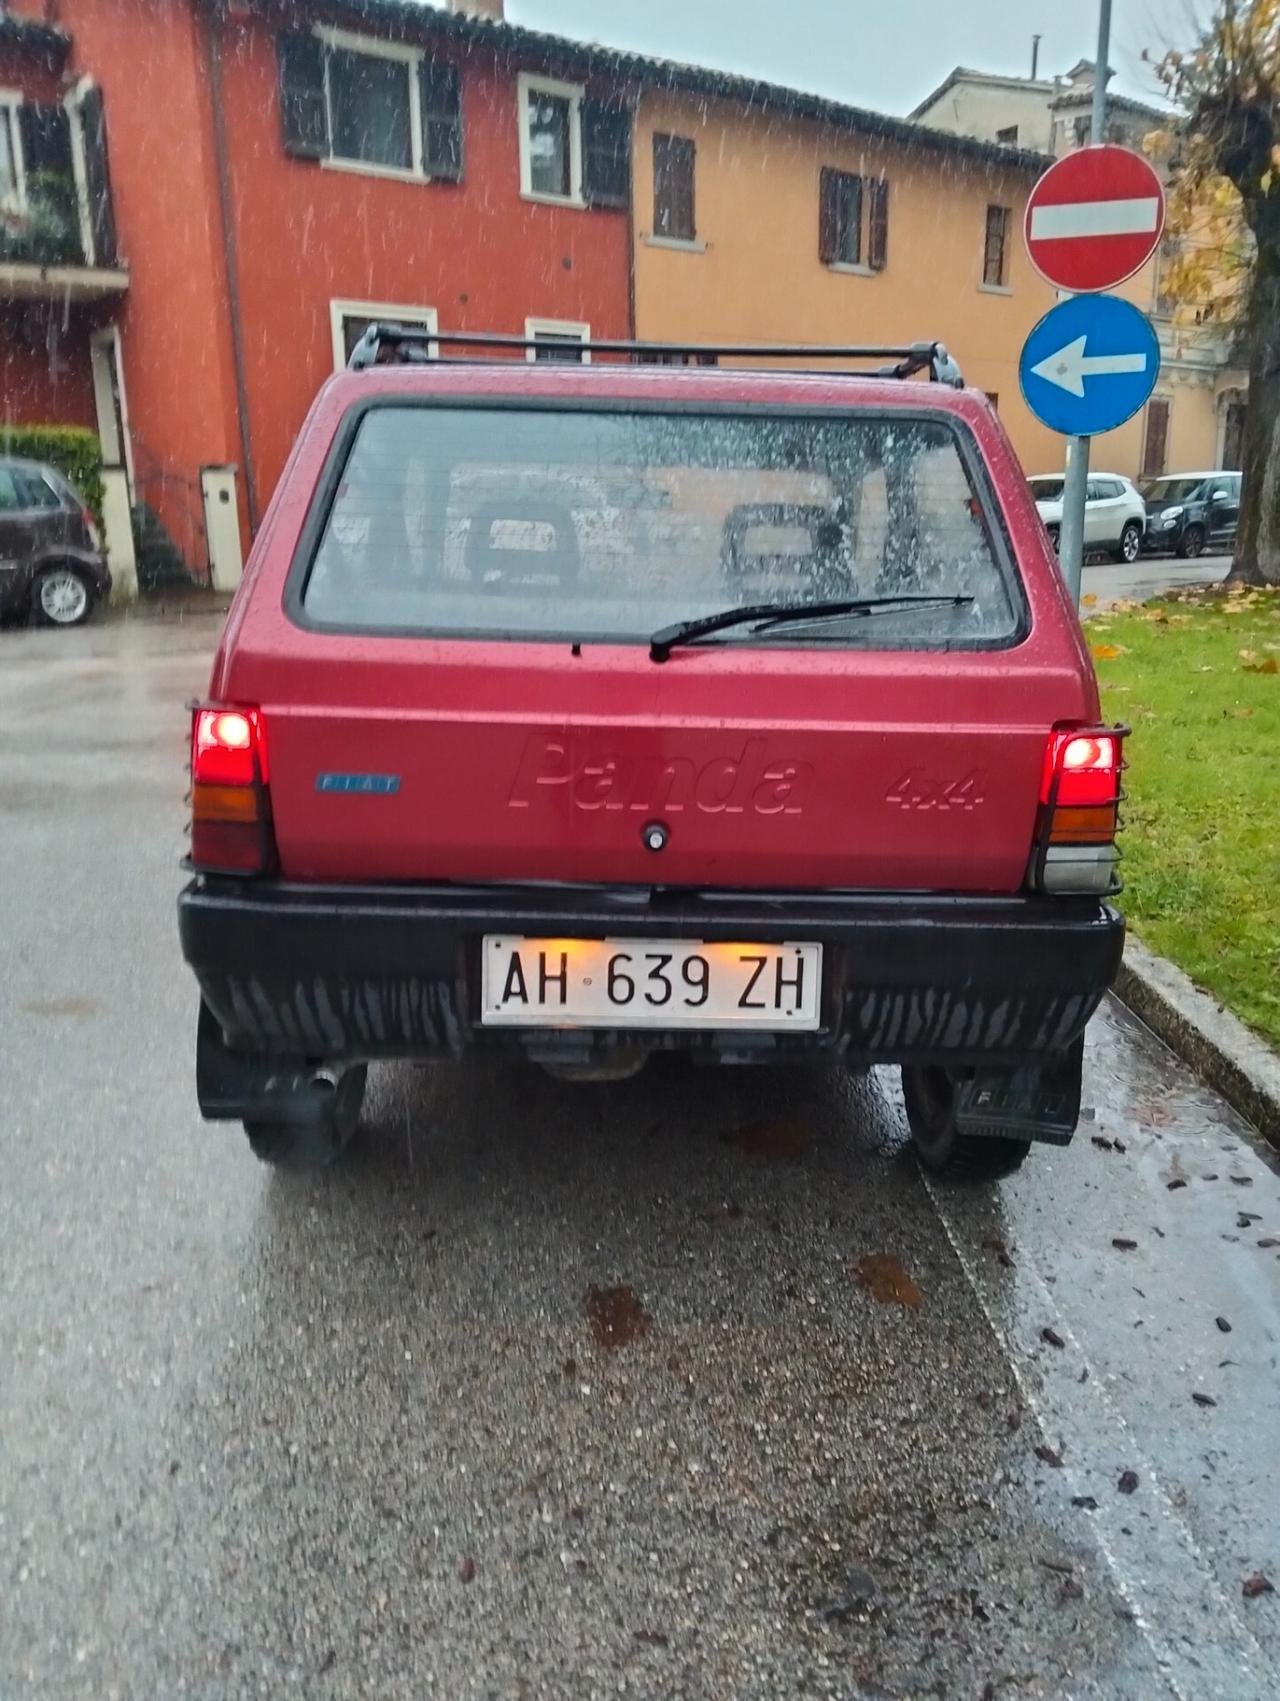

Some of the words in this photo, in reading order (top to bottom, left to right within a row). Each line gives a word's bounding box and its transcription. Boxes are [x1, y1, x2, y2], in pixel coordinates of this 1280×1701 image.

[321, 774, 399, 794] FIAT
[508, 733, 815, 814] Panda
[884, 767, 986, 811] 4x4
[502, 951, 568, 1004] AH
[607, 953, 710, 1006] 639
[738, 956, 805, 1009] ZH
